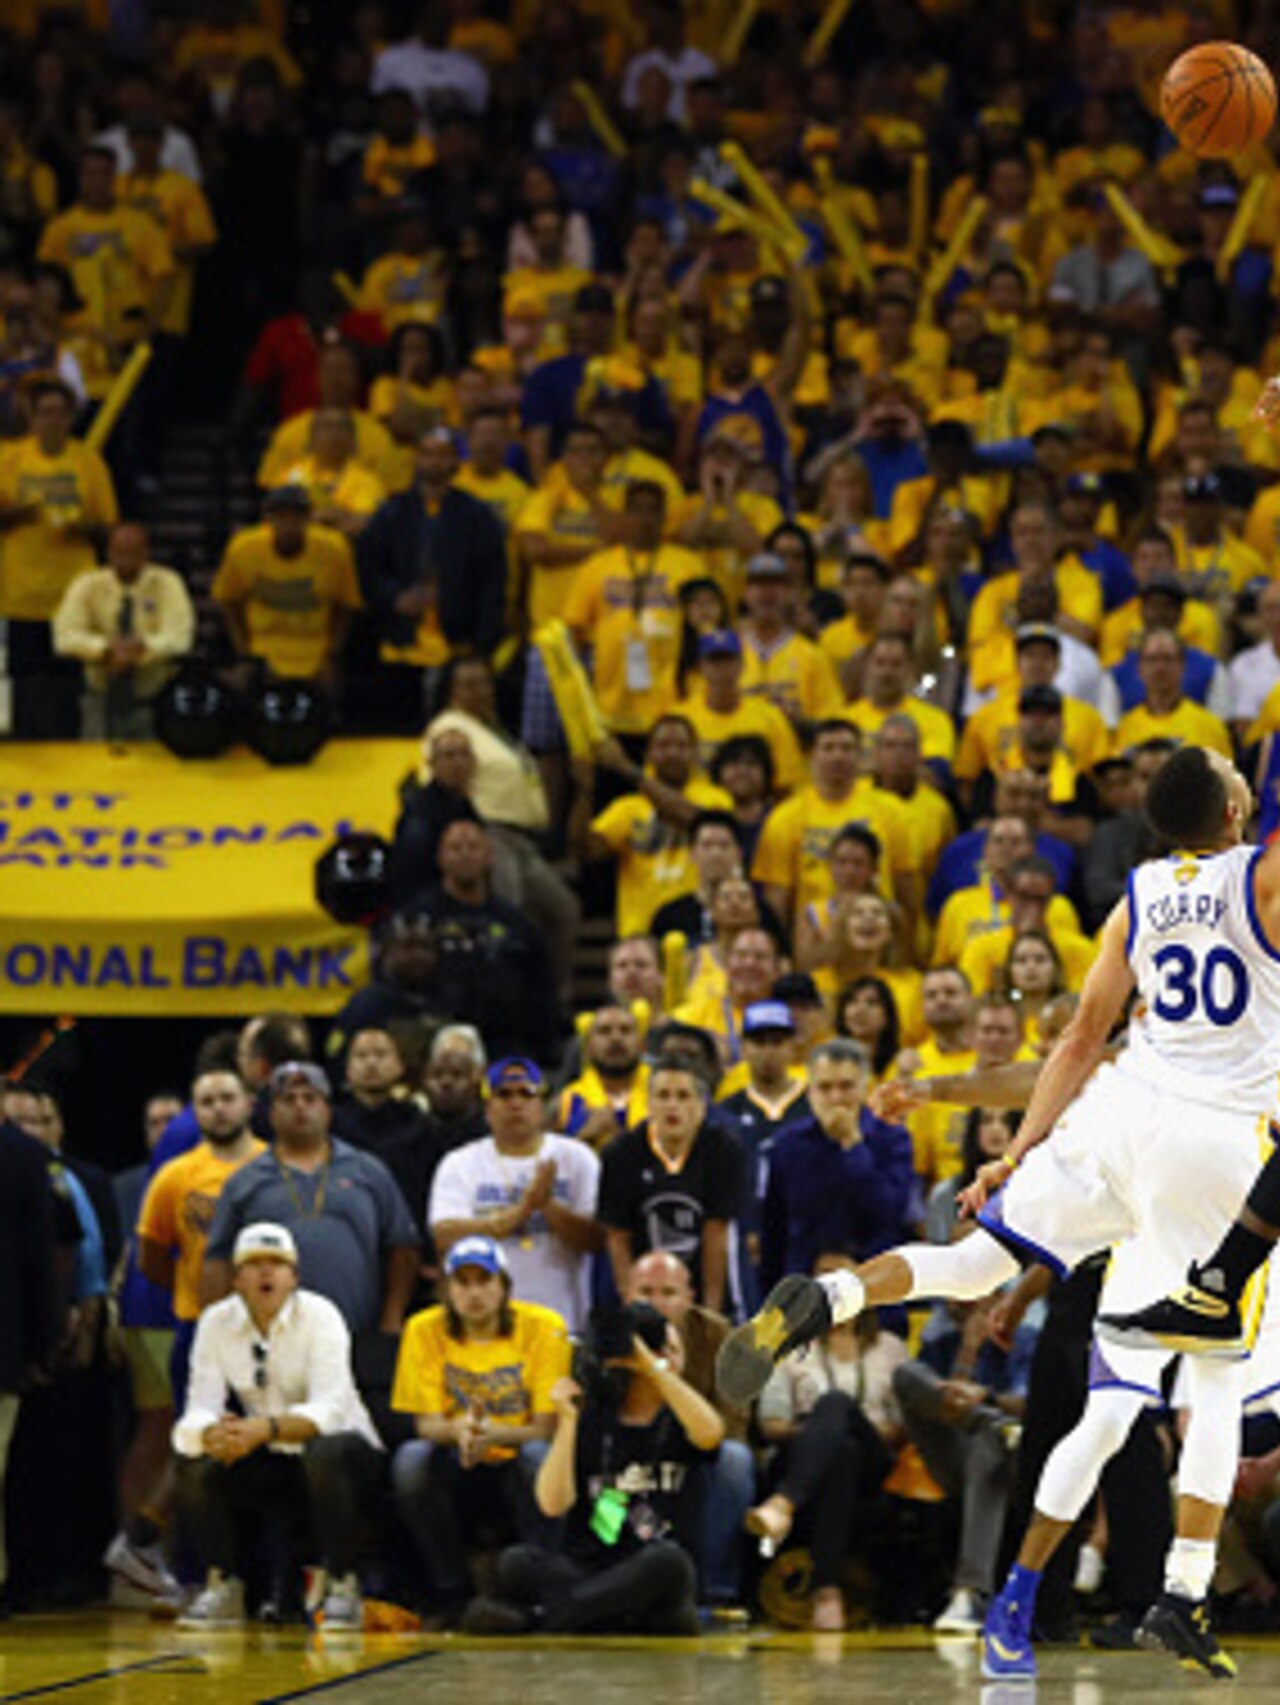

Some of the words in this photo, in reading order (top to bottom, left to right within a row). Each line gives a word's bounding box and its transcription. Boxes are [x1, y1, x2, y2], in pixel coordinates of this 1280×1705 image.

[1147, 894, 1229, 933] CURRY
[181, 936, 357, 988] BANK
[1153, 944, 1249, 1026] 30
